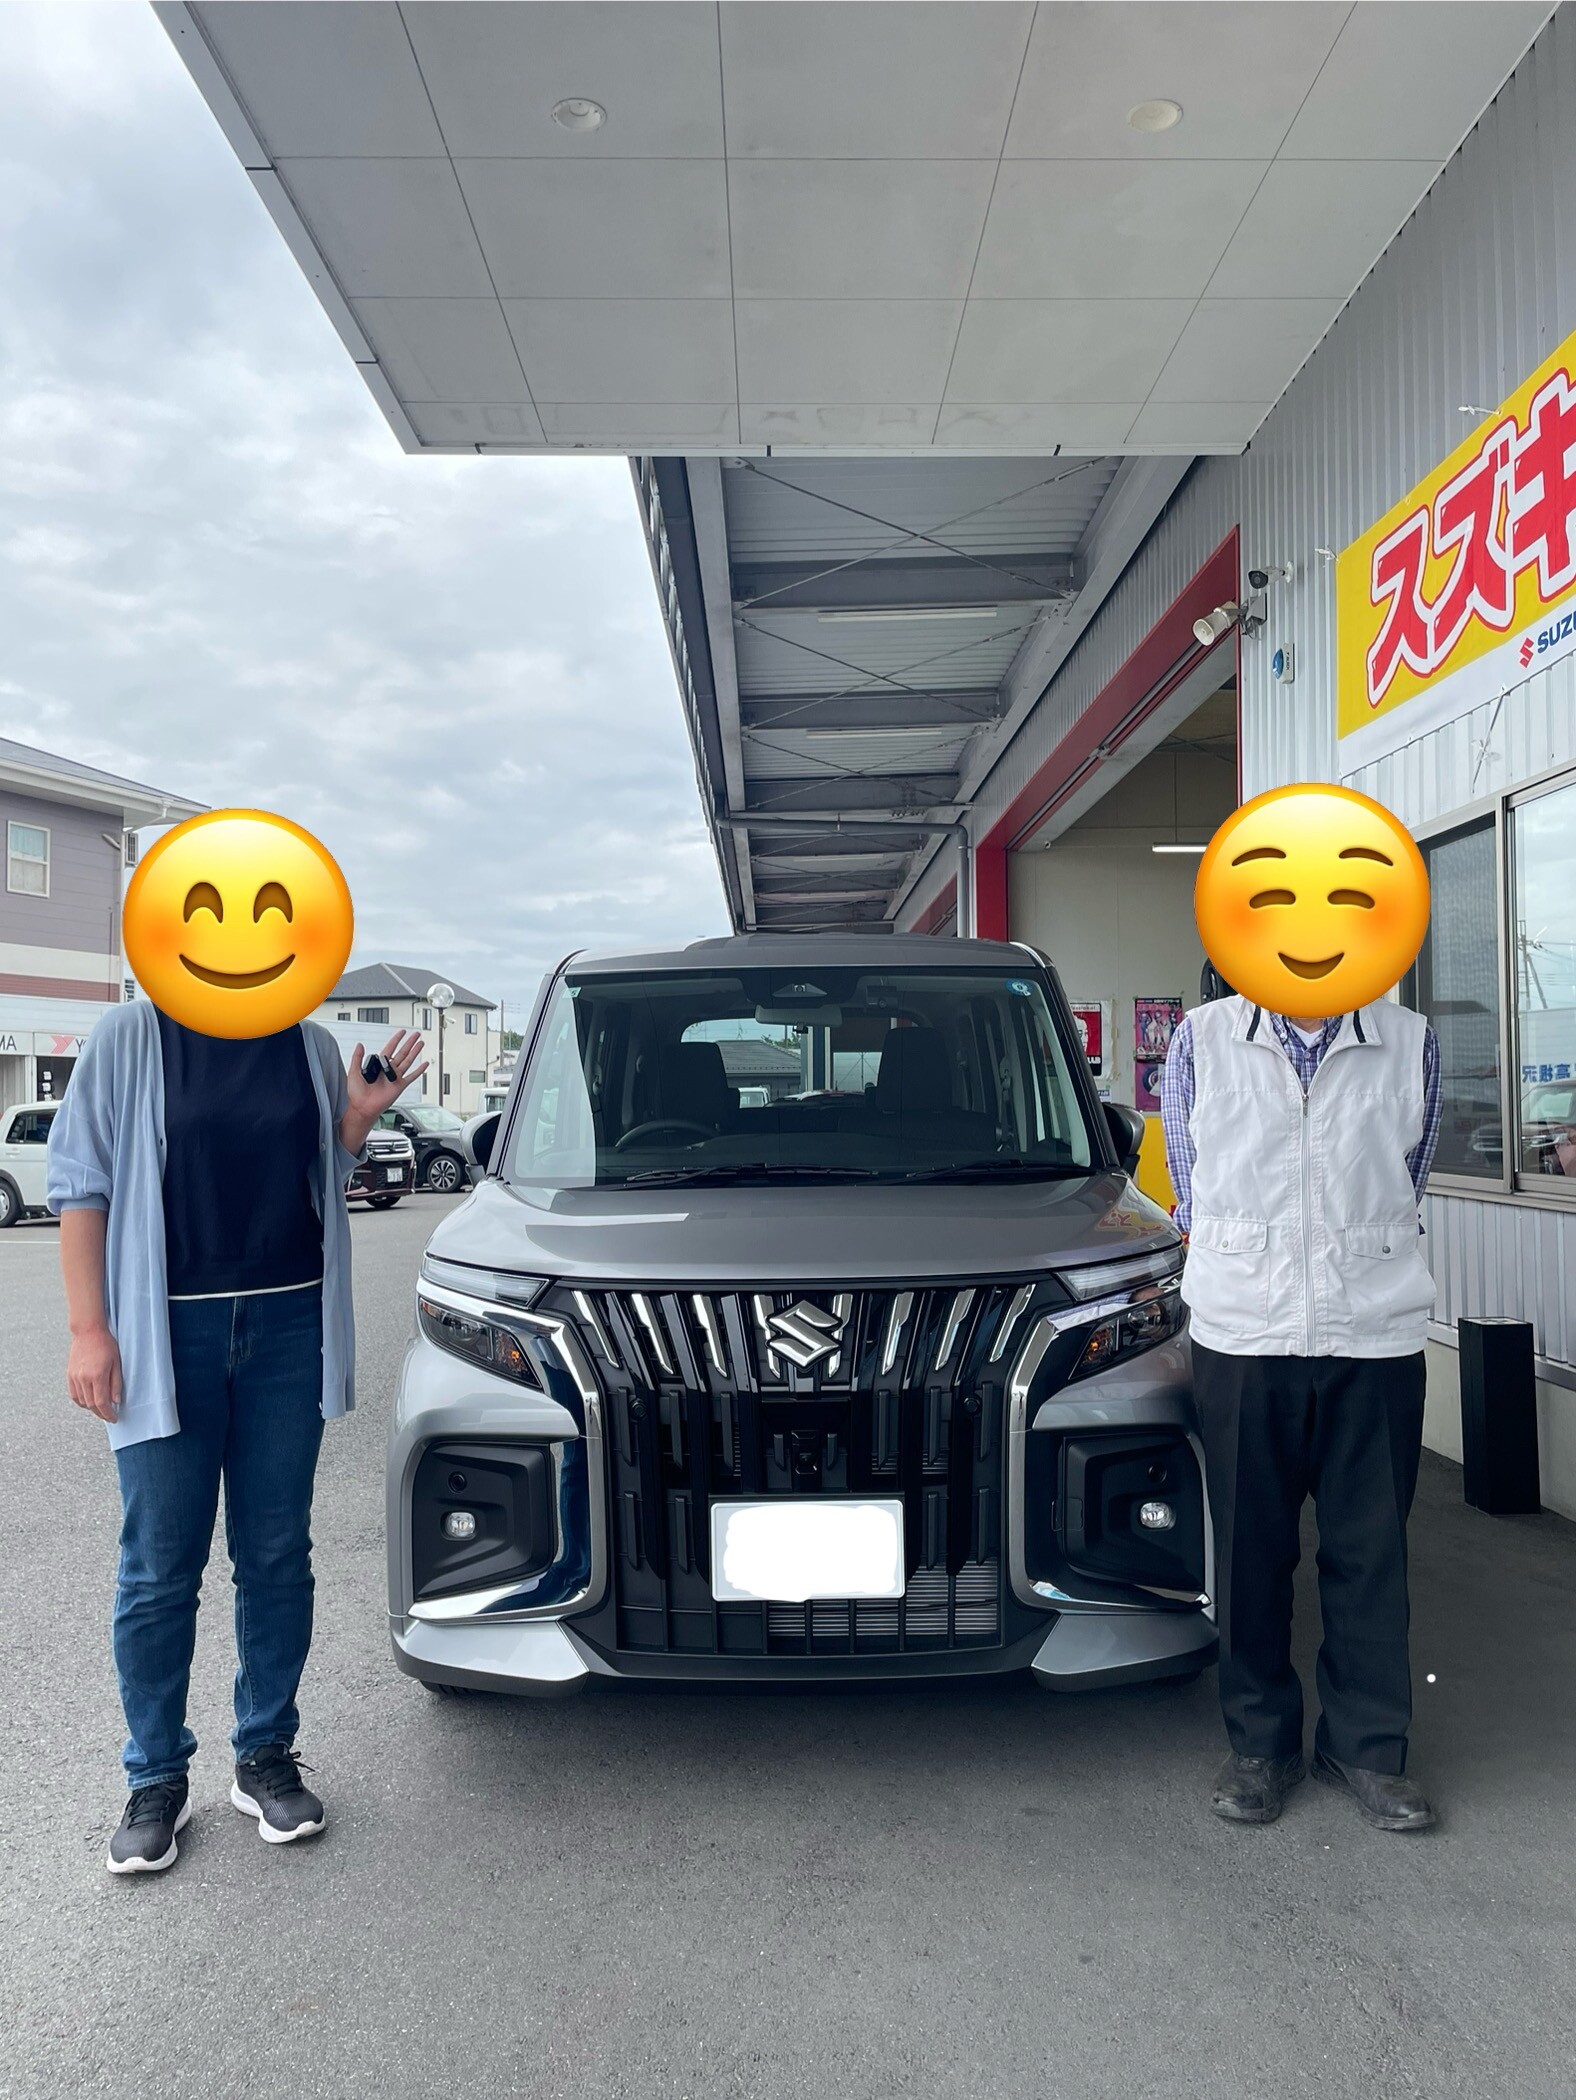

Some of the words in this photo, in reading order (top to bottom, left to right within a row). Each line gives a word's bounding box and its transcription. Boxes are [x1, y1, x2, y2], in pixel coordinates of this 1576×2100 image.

[1368, 368, 1576, 706] スズキ
[1537, 610, 1576, 654] SUZ
